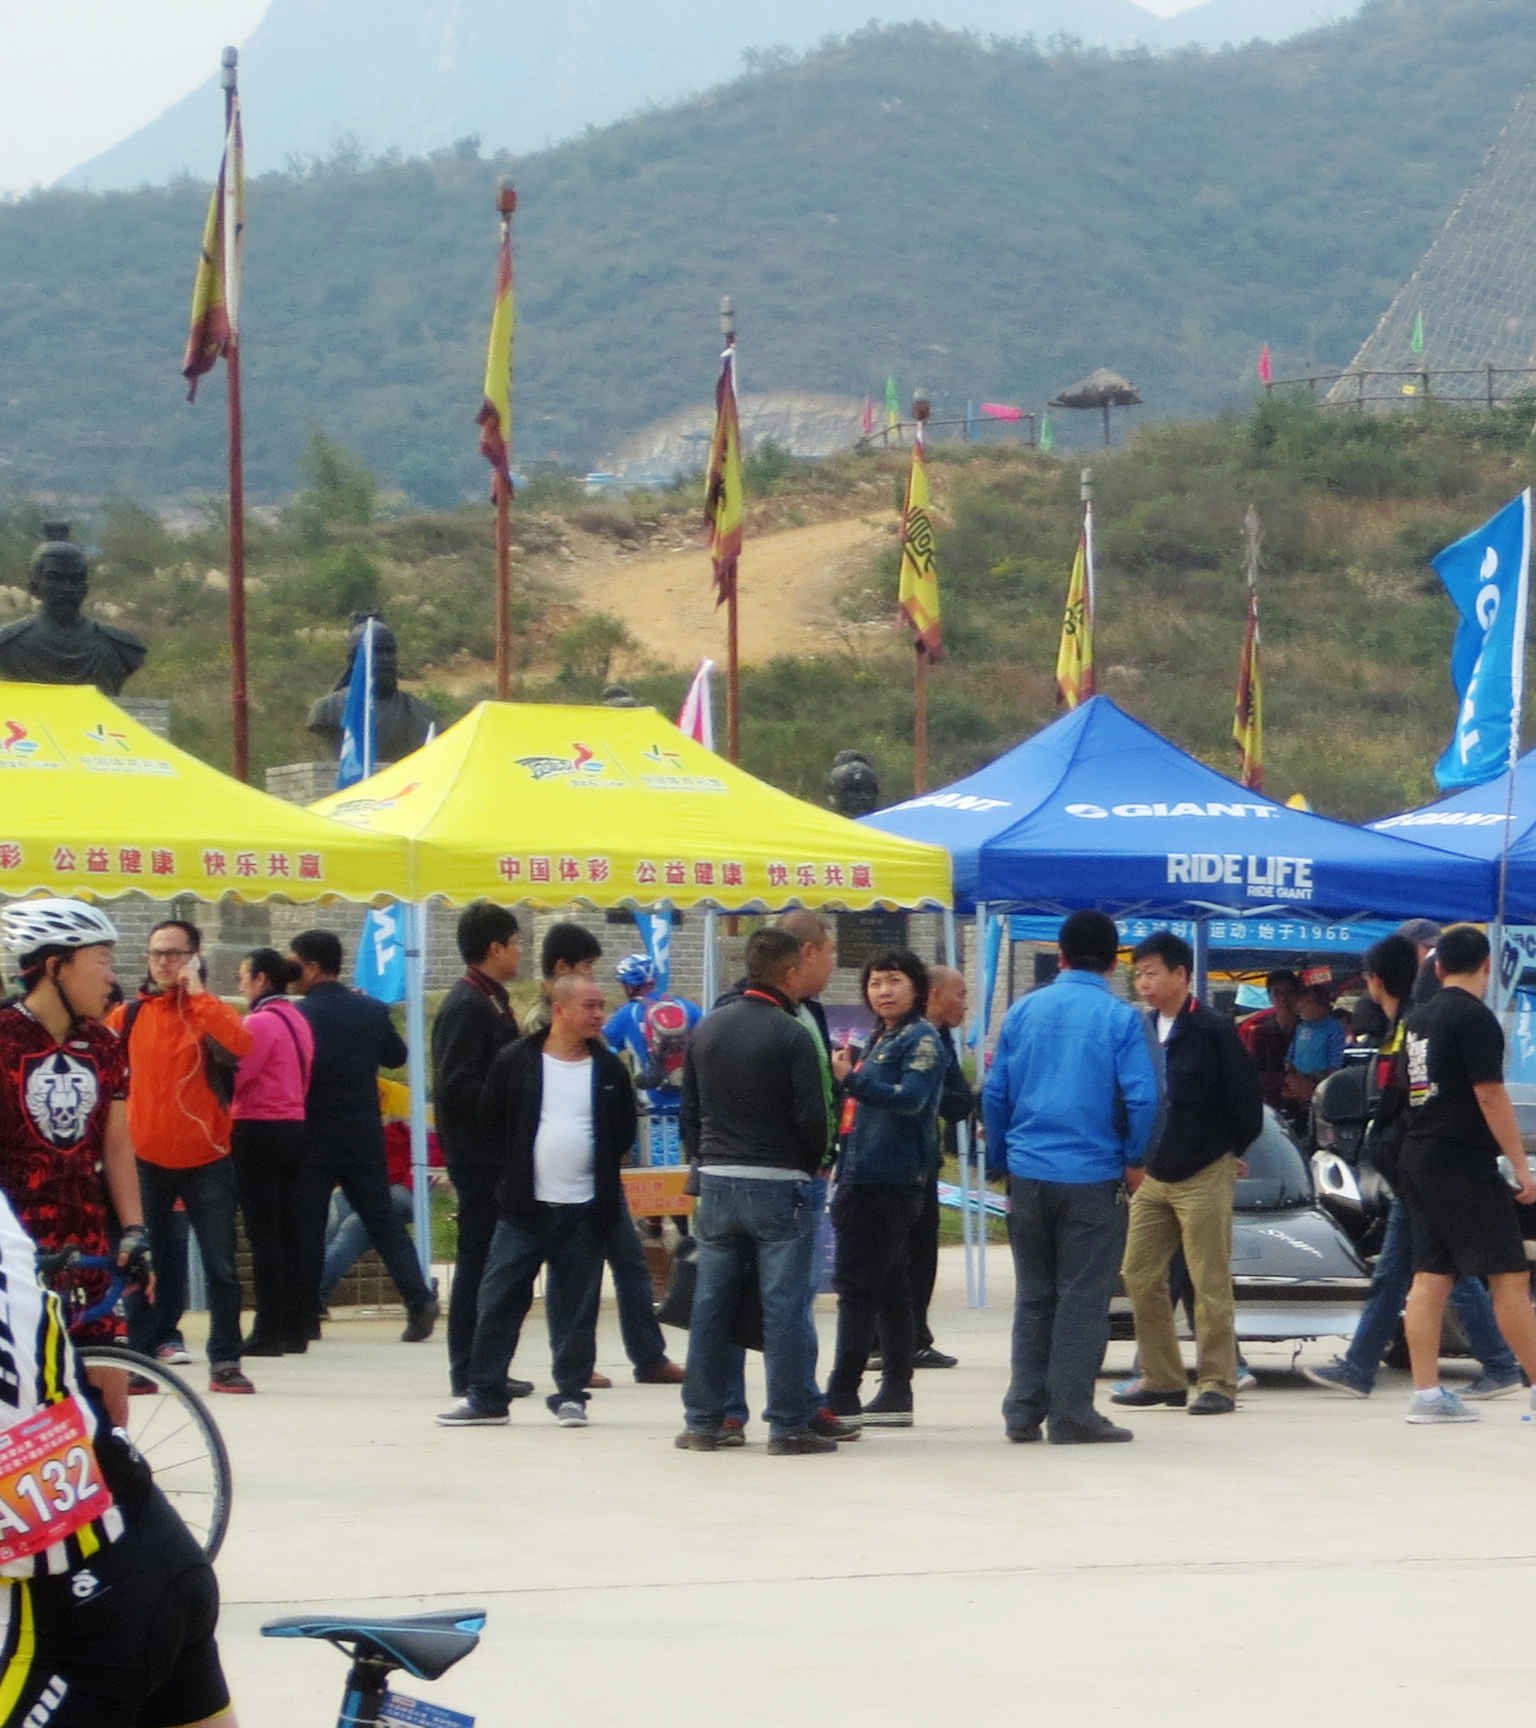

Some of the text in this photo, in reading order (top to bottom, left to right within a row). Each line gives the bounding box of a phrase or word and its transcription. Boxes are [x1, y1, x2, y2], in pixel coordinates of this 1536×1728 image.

[1126, 803, 1268, 818] GIANT
[53, 847, 175, 876] 公益健康
[204, 851, 323, 880] 快乐共赢
[499, 856, 873, 889] 中国体彩 公益健康 快乐共赢
[1167, 853, 1313, 887] RIDE LIFE
[1247, 885, 1313, 900] RIDE GIANT
